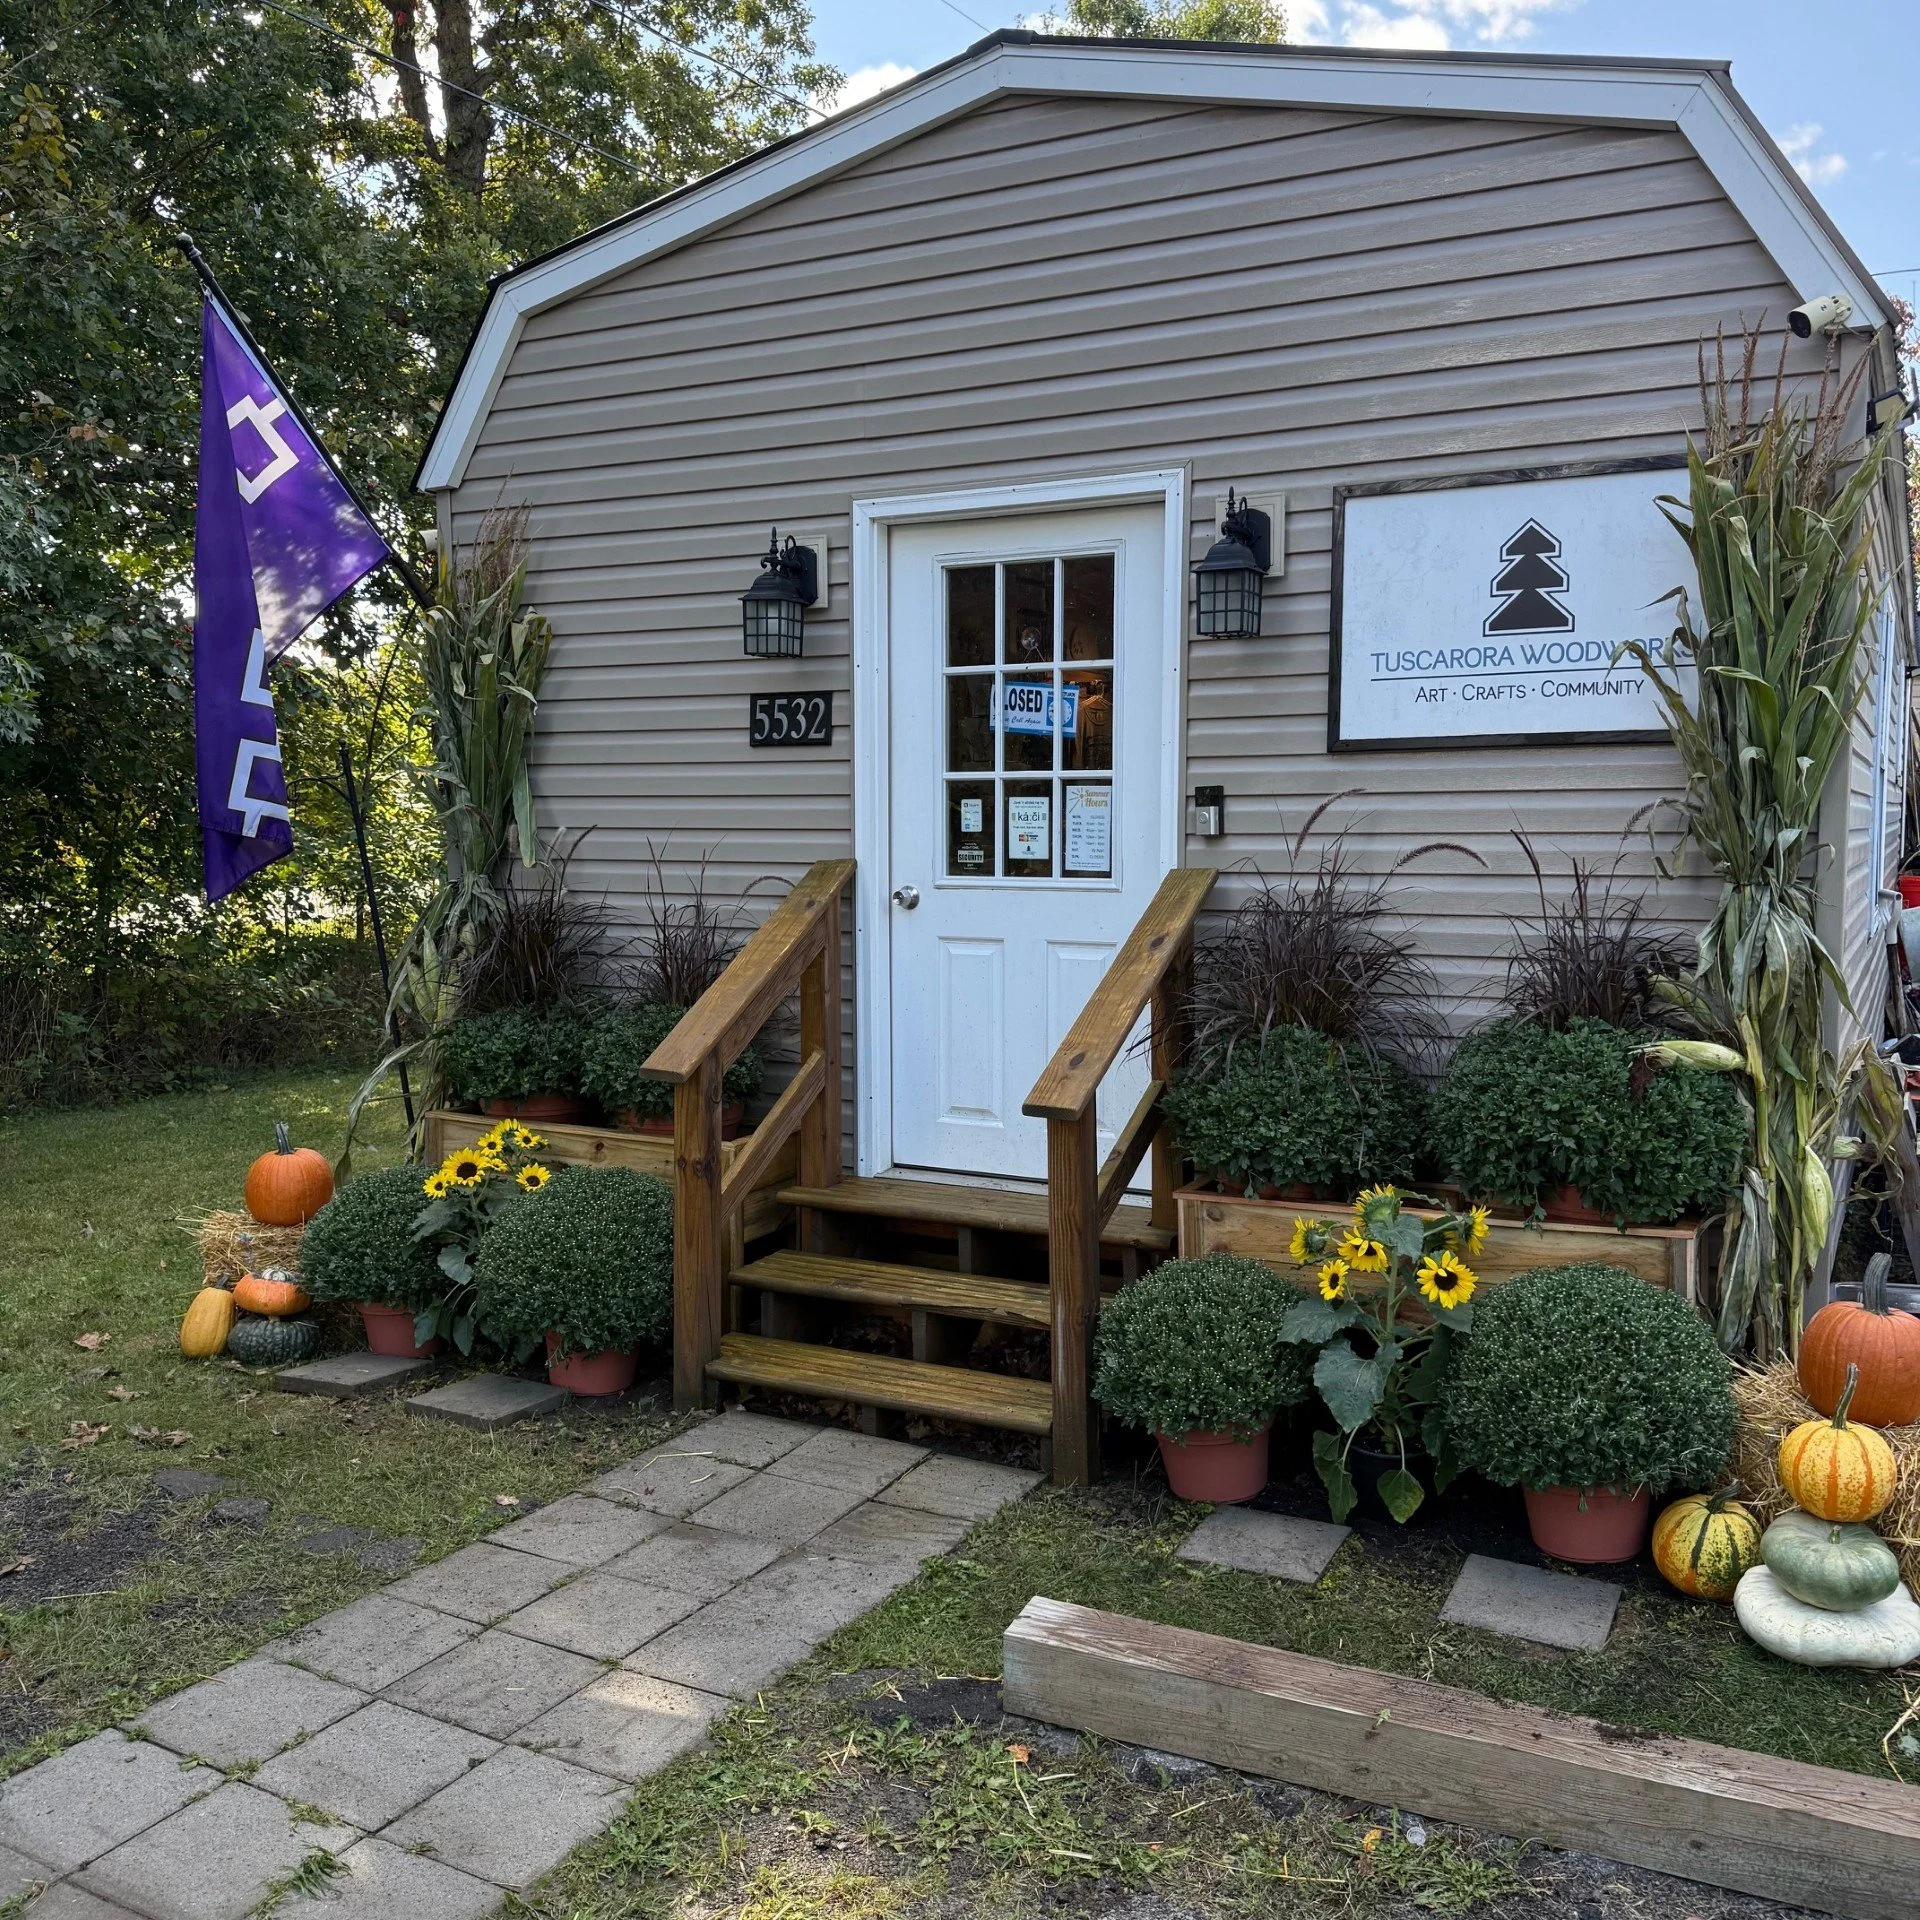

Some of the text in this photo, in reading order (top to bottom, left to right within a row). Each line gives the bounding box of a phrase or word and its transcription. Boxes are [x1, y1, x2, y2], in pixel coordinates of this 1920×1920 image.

[1370, 645, 1515, 673] TUSCARORA
[993, 687, 1043, 713] OSED
[1415, 679, 1645, 703] ART CRAFTS COMMUNITY
[754, 697, 827, 740] 5532
[1085, 797, 1109, 808] Hours
[958, 853, 984, 861] SECURITY
